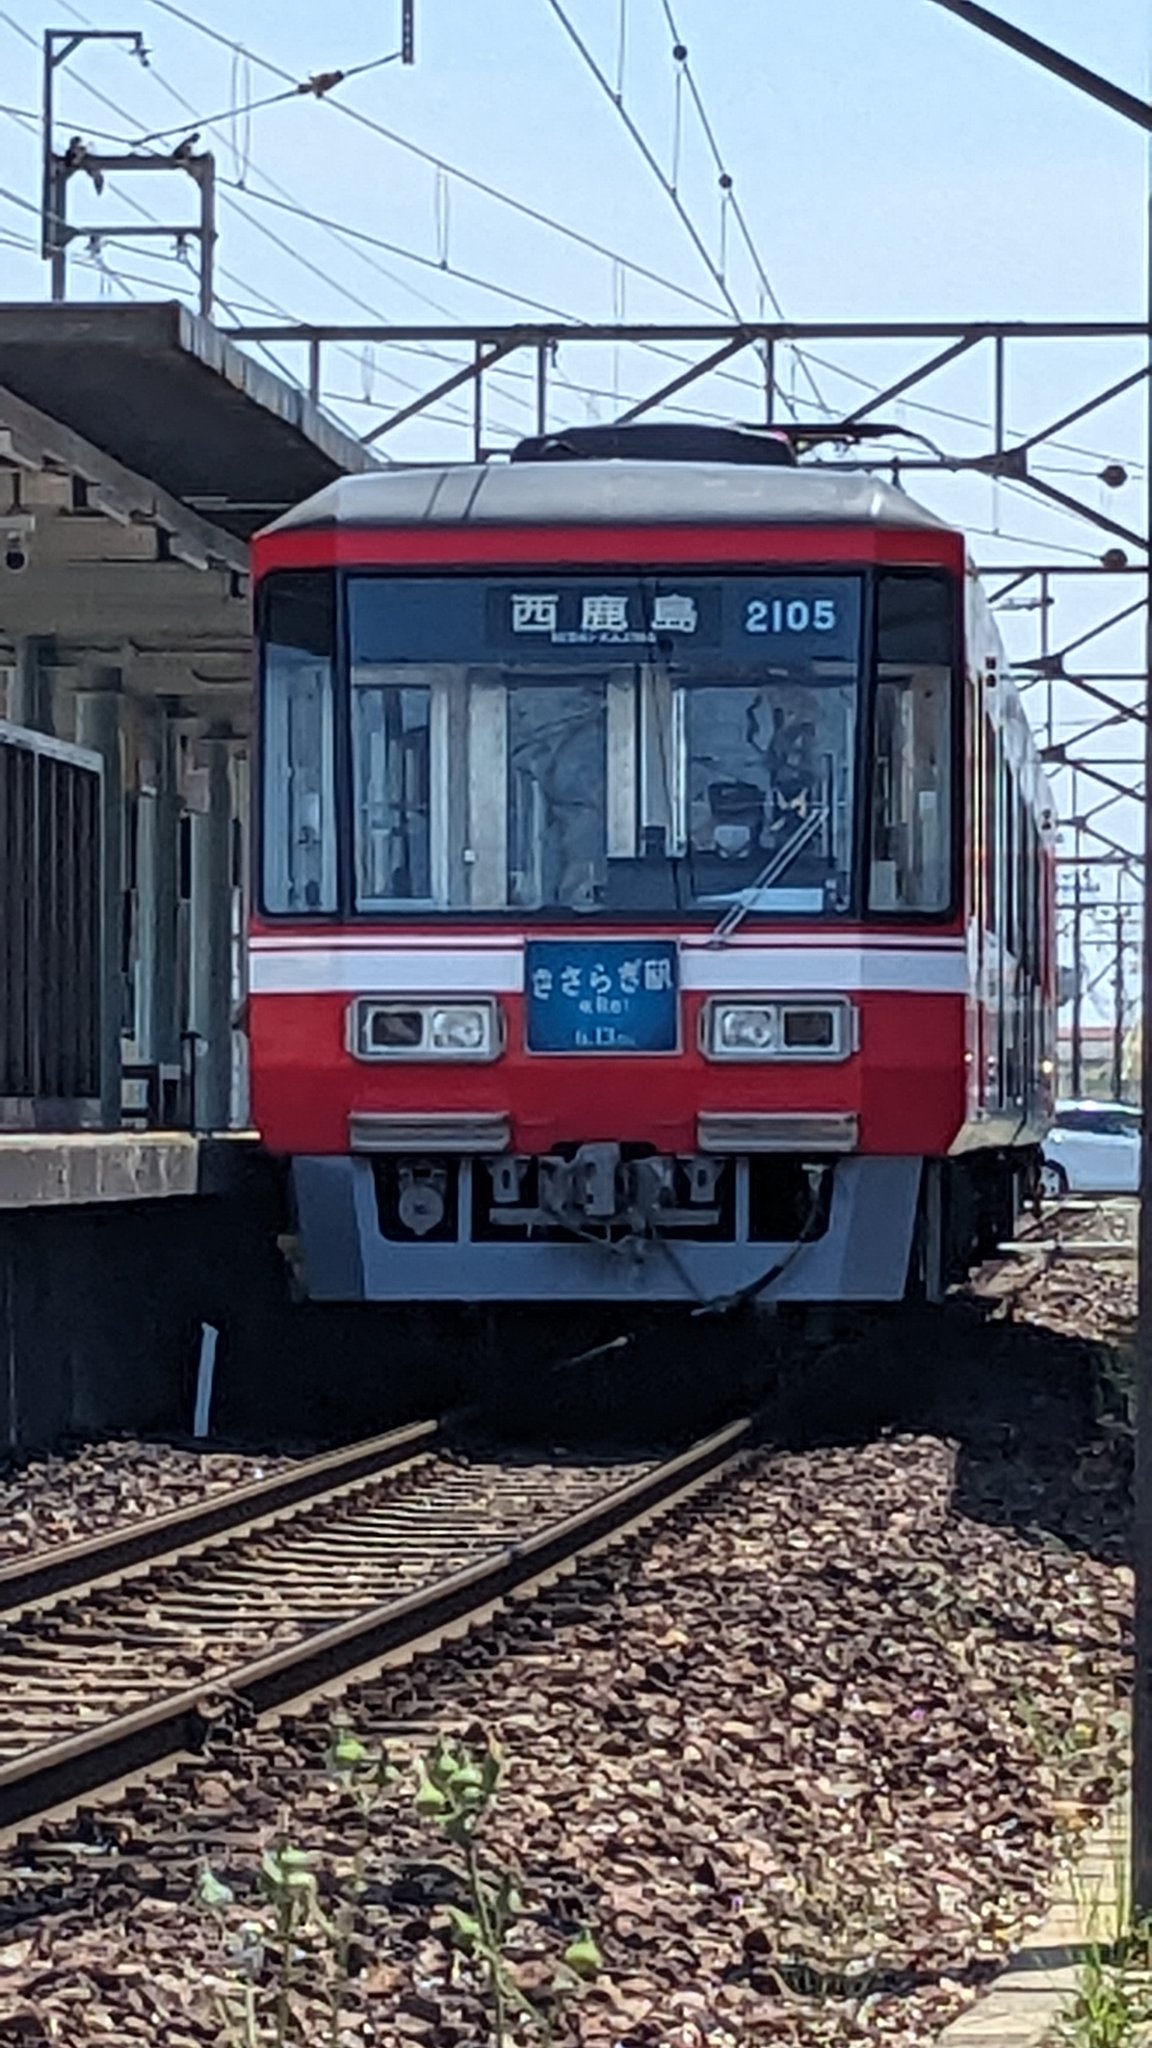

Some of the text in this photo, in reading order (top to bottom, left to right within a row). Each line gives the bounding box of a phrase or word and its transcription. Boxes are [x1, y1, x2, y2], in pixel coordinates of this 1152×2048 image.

[511, 594, 698, 633] 西鹿島
[745, 599, 836, 632] 2105
